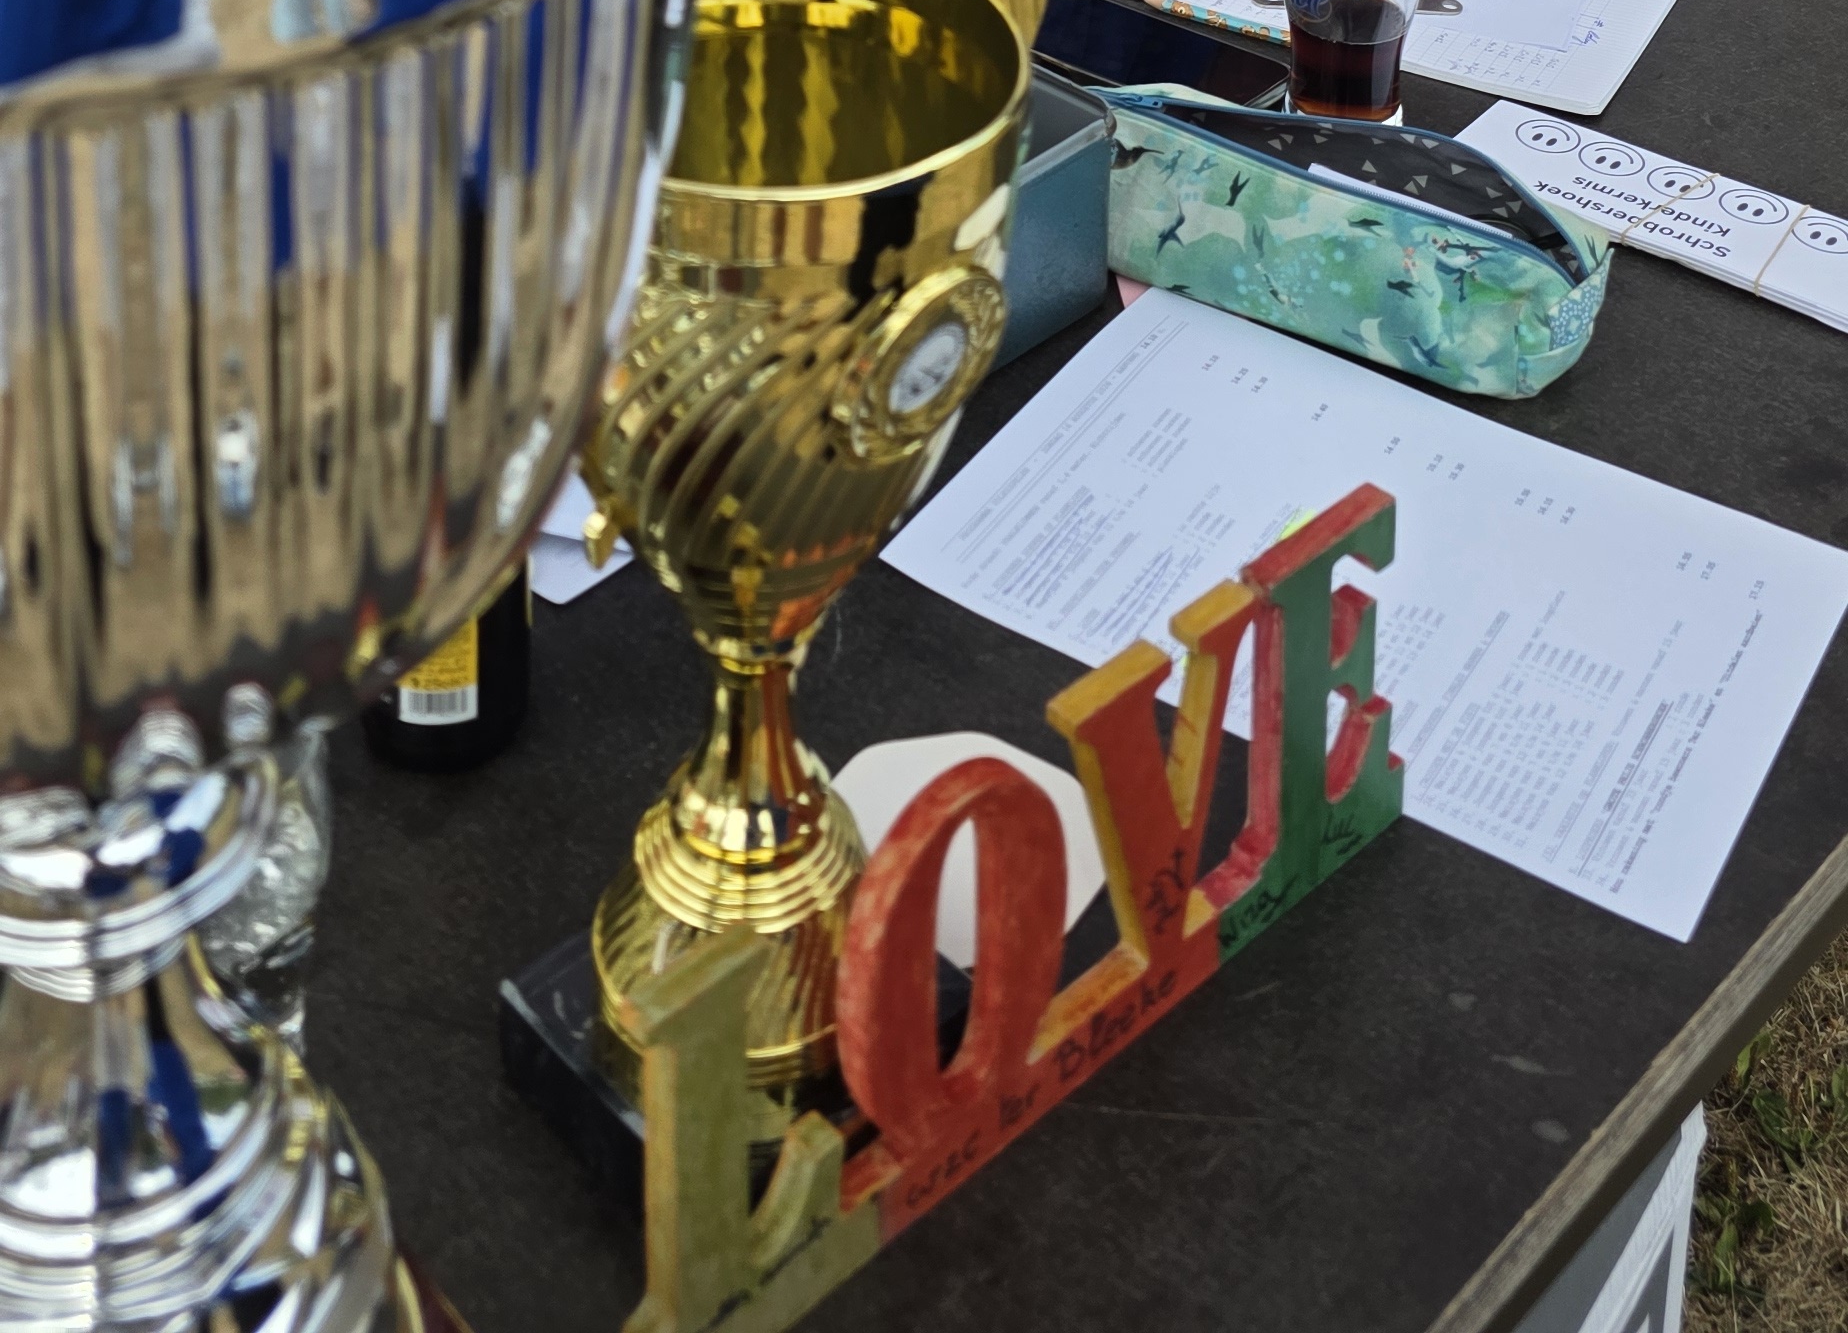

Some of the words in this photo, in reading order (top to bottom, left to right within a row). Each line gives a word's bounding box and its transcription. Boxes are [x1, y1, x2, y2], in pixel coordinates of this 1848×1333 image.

[1533, 179, 1731, 259] Schrobbershoek
[1572, 175, 1731, 238] Kinderkermis
[617, 483, 1406, 1333] LOVE
